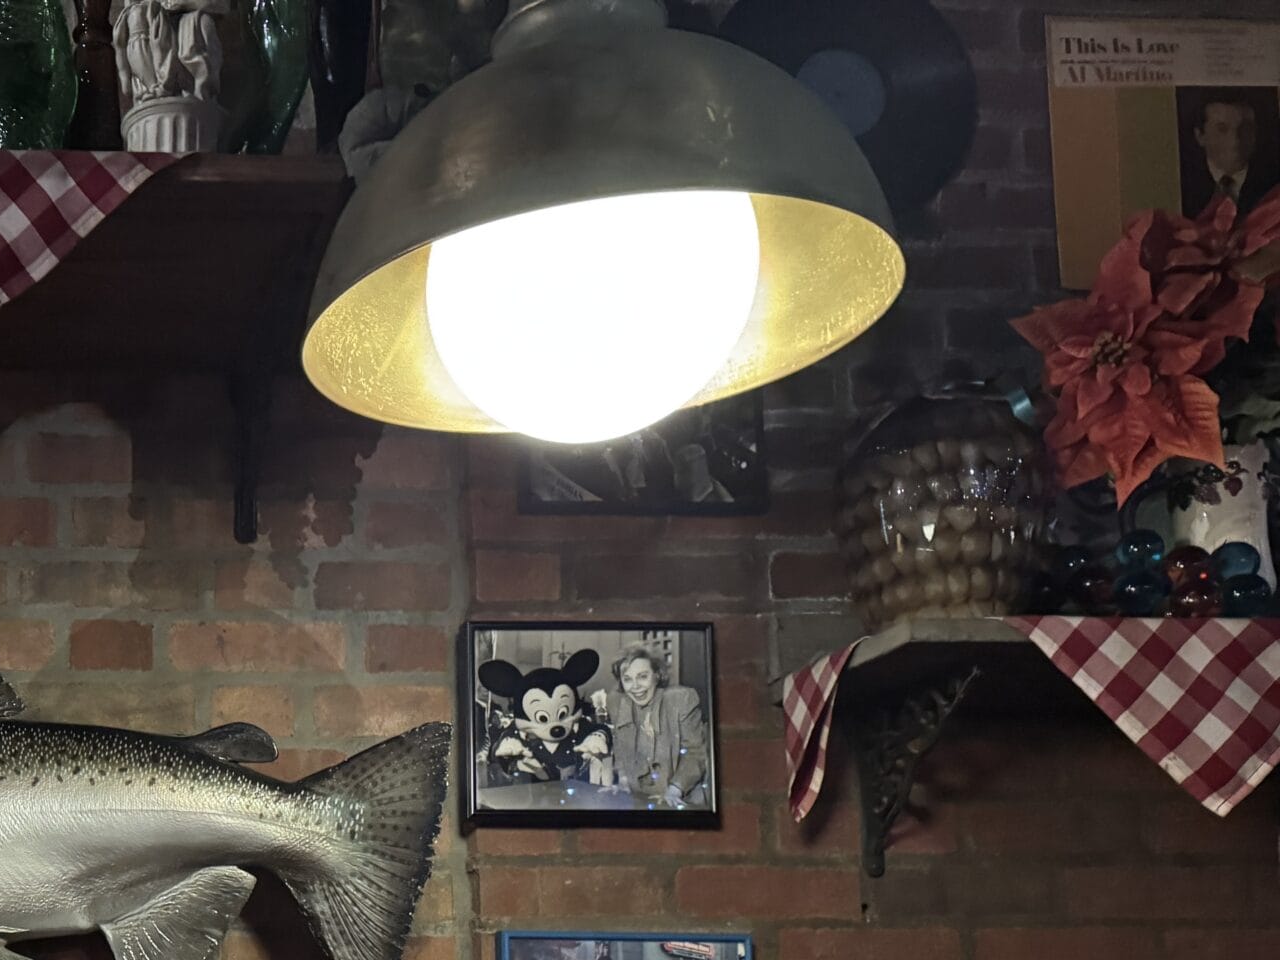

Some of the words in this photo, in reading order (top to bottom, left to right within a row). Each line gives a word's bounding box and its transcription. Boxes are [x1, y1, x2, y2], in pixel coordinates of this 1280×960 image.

[1060, 37, 1108, 54] This
[1113, 38, 1130, 54] Is
[1136, 38, 1180, 54] Love
